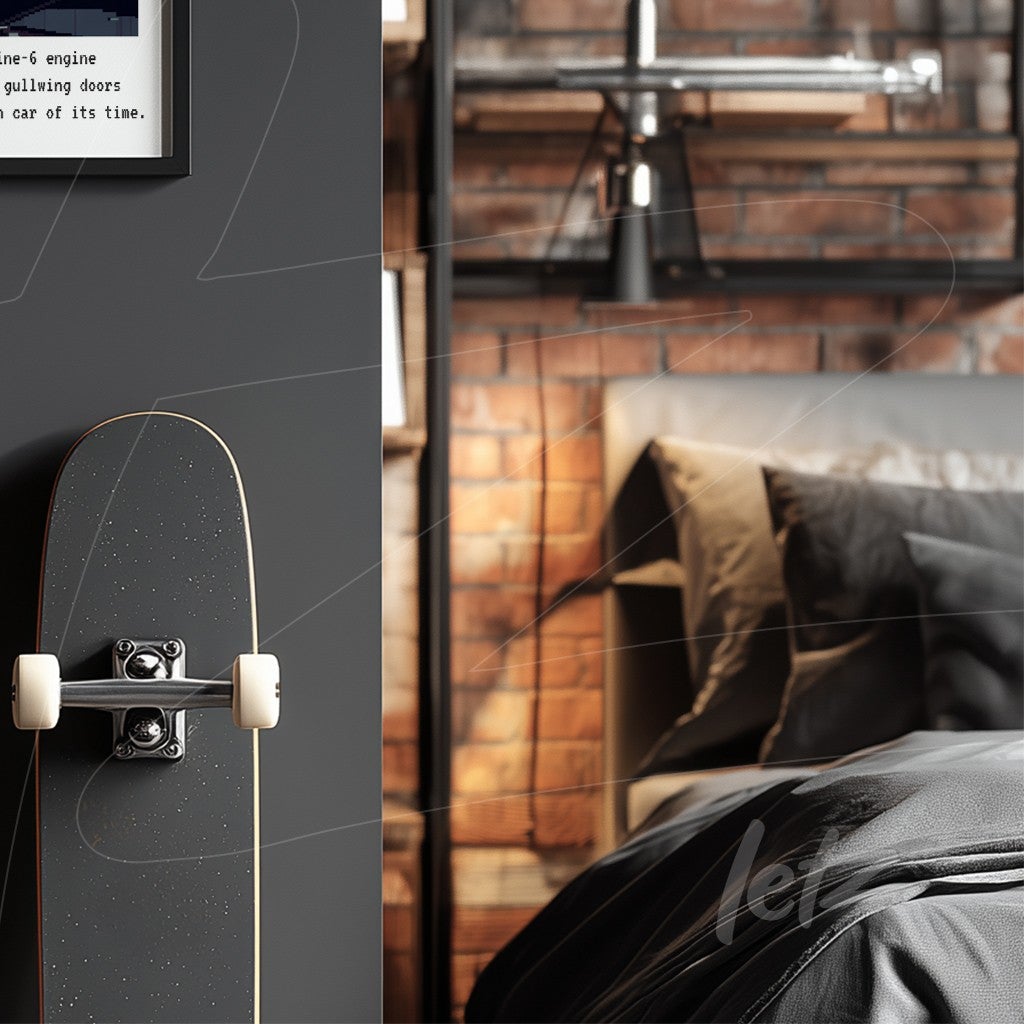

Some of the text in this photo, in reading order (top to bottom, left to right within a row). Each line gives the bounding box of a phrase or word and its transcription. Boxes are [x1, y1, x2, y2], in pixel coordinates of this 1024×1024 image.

[45, 50, 97, 68] engine
[3, 78, 72, 96] gullwing
[79, 78, 121, 92] doors
[12, 108, 38, 120] car
[45, 105, 62, 120] of
[71, 105, 96, 120] its
[104, 105, 145, 120] time.
